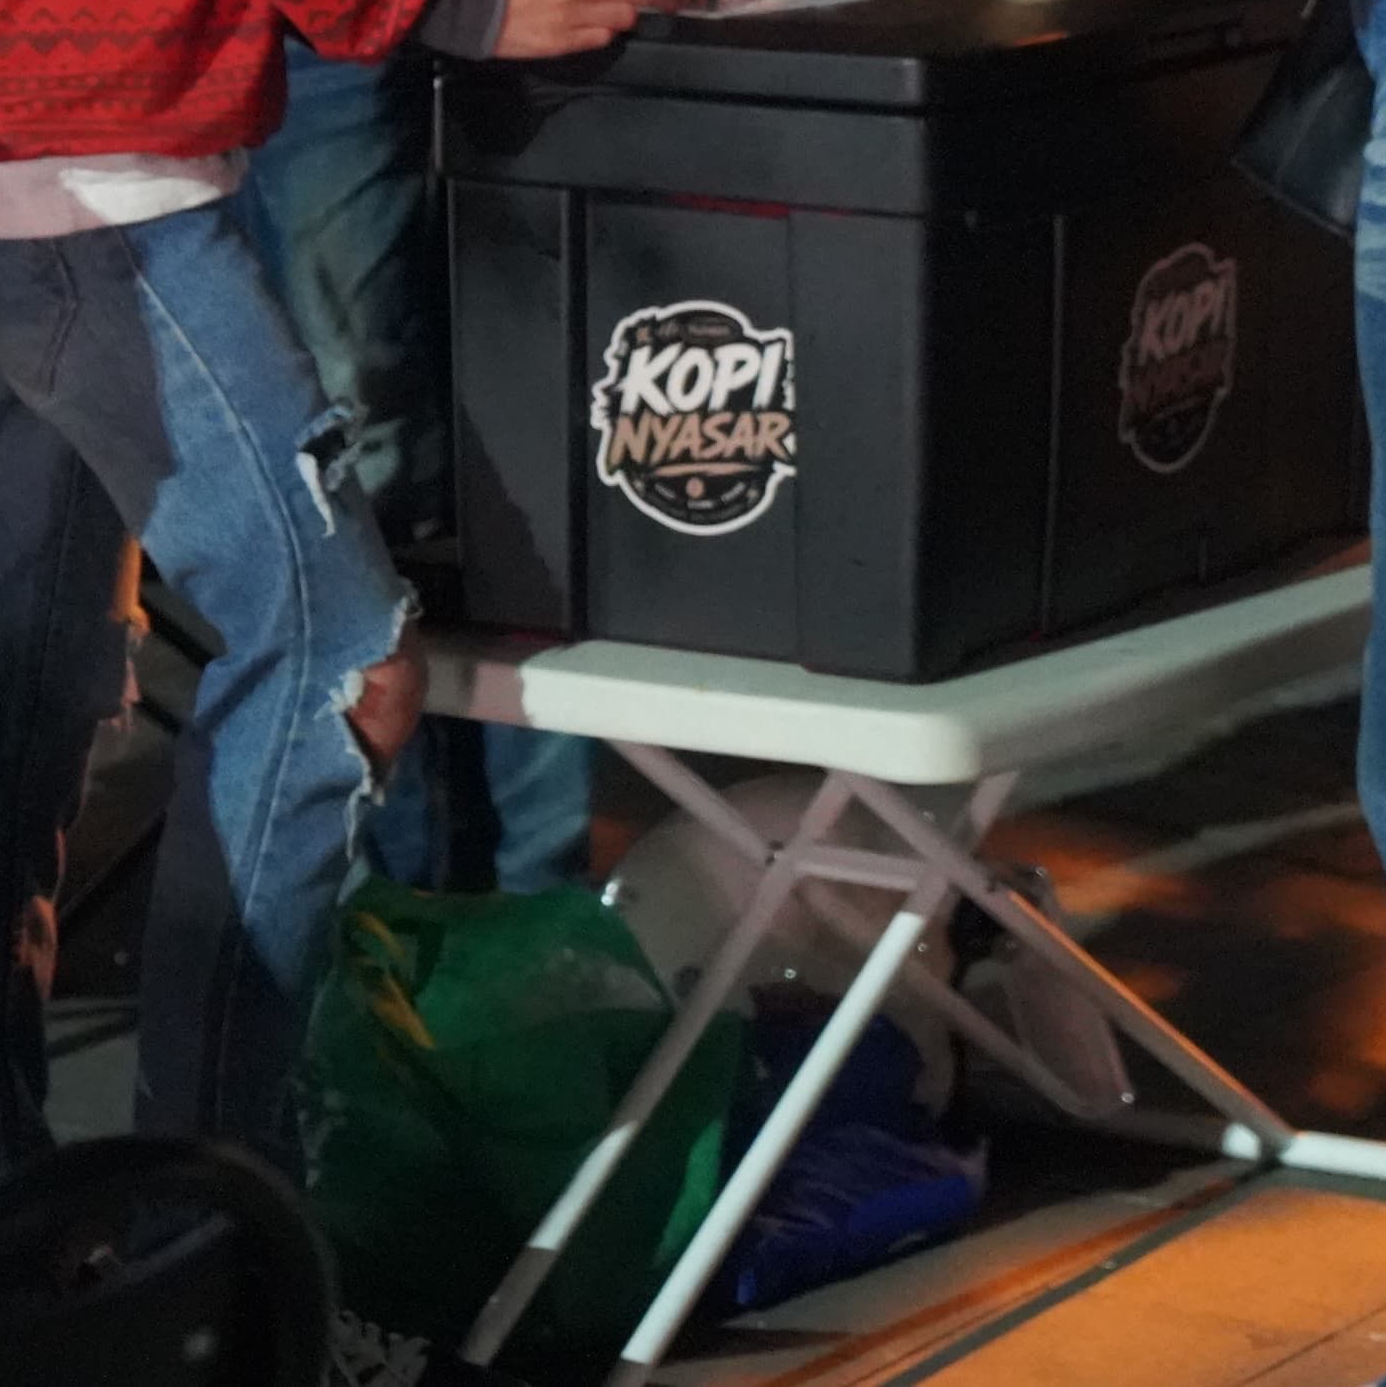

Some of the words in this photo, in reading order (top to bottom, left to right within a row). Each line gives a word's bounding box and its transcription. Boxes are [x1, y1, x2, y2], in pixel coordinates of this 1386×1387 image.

[1138, 282, 1224, 366] KOPI
[615, 341, 785, 416] KOPI
[611, 410, 792, 466] NYASAR
